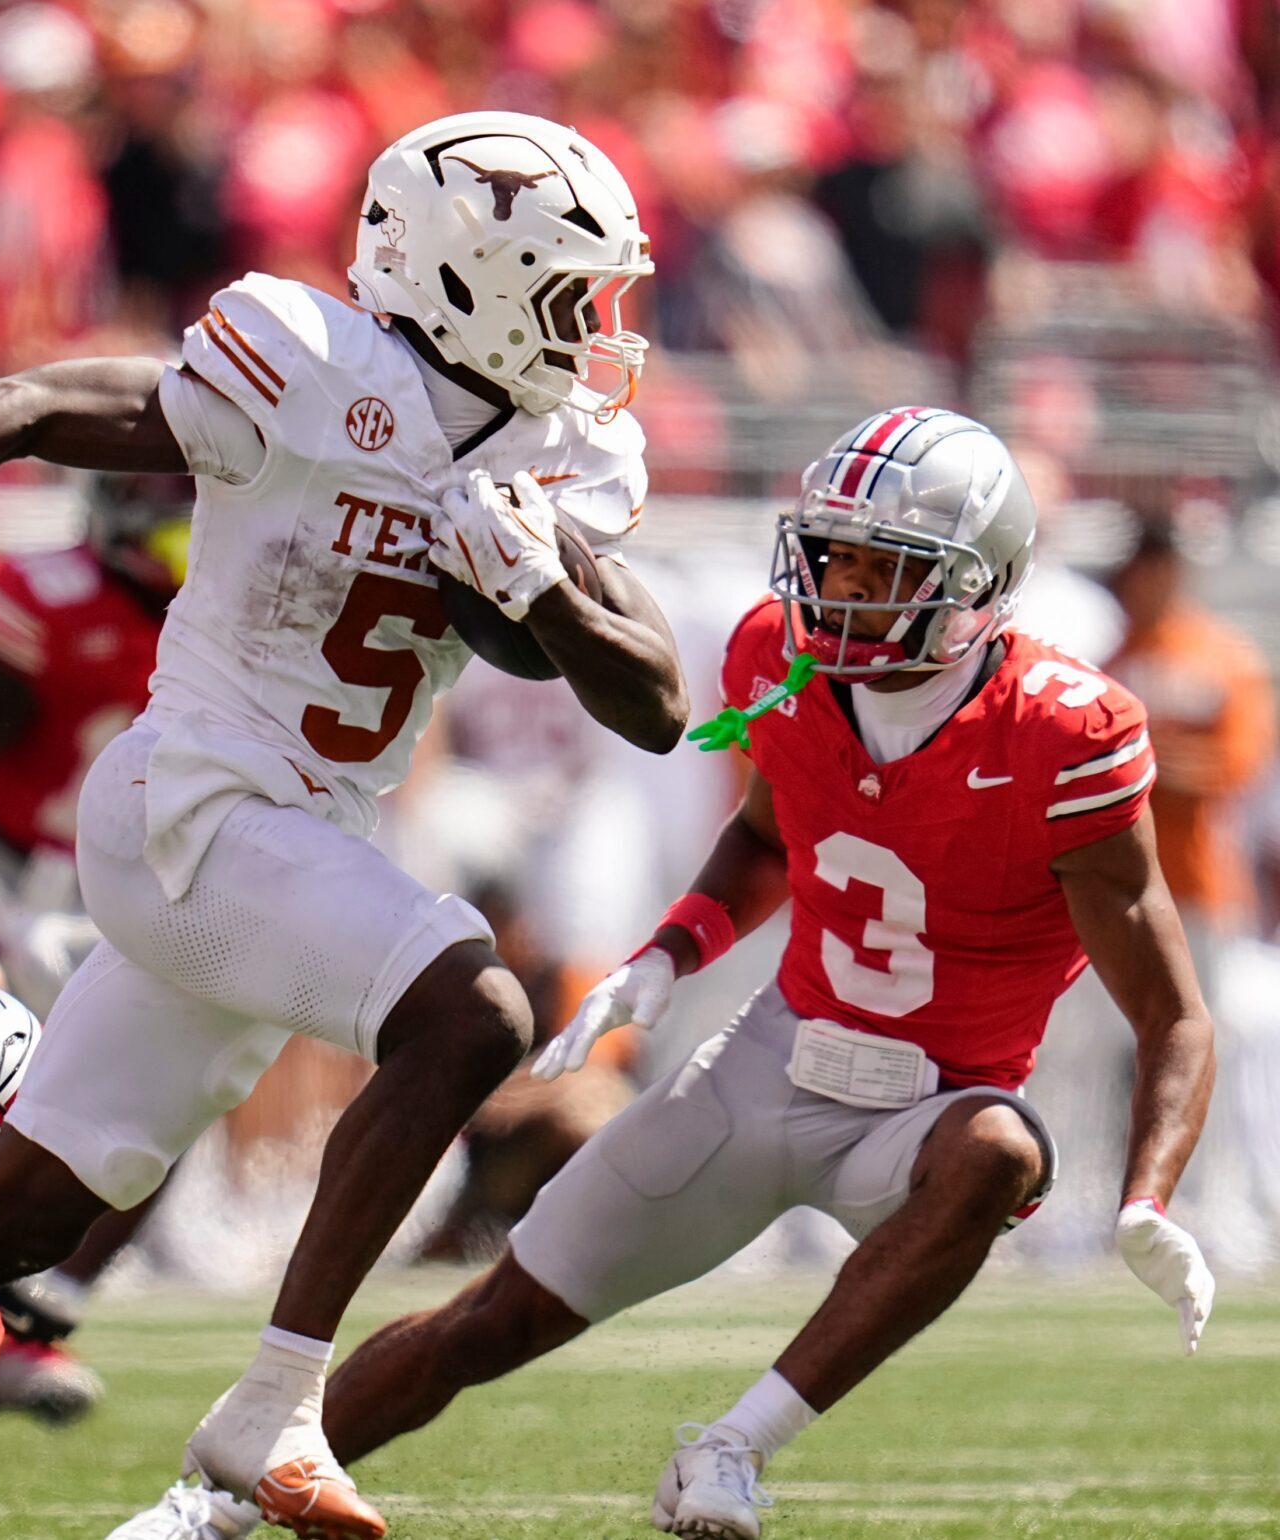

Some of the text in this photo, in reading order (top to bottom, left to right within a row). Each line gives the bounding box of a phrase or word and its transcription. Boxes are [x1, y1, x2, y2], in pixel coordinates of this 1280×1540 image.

[348, 399, 393, 449] SEC
[300, 571, 452, 763] 5
[1022, 661, 1108, 708] 3
[749, 676, 798, 718] BG
[814, 831, 934, 1018] 3
